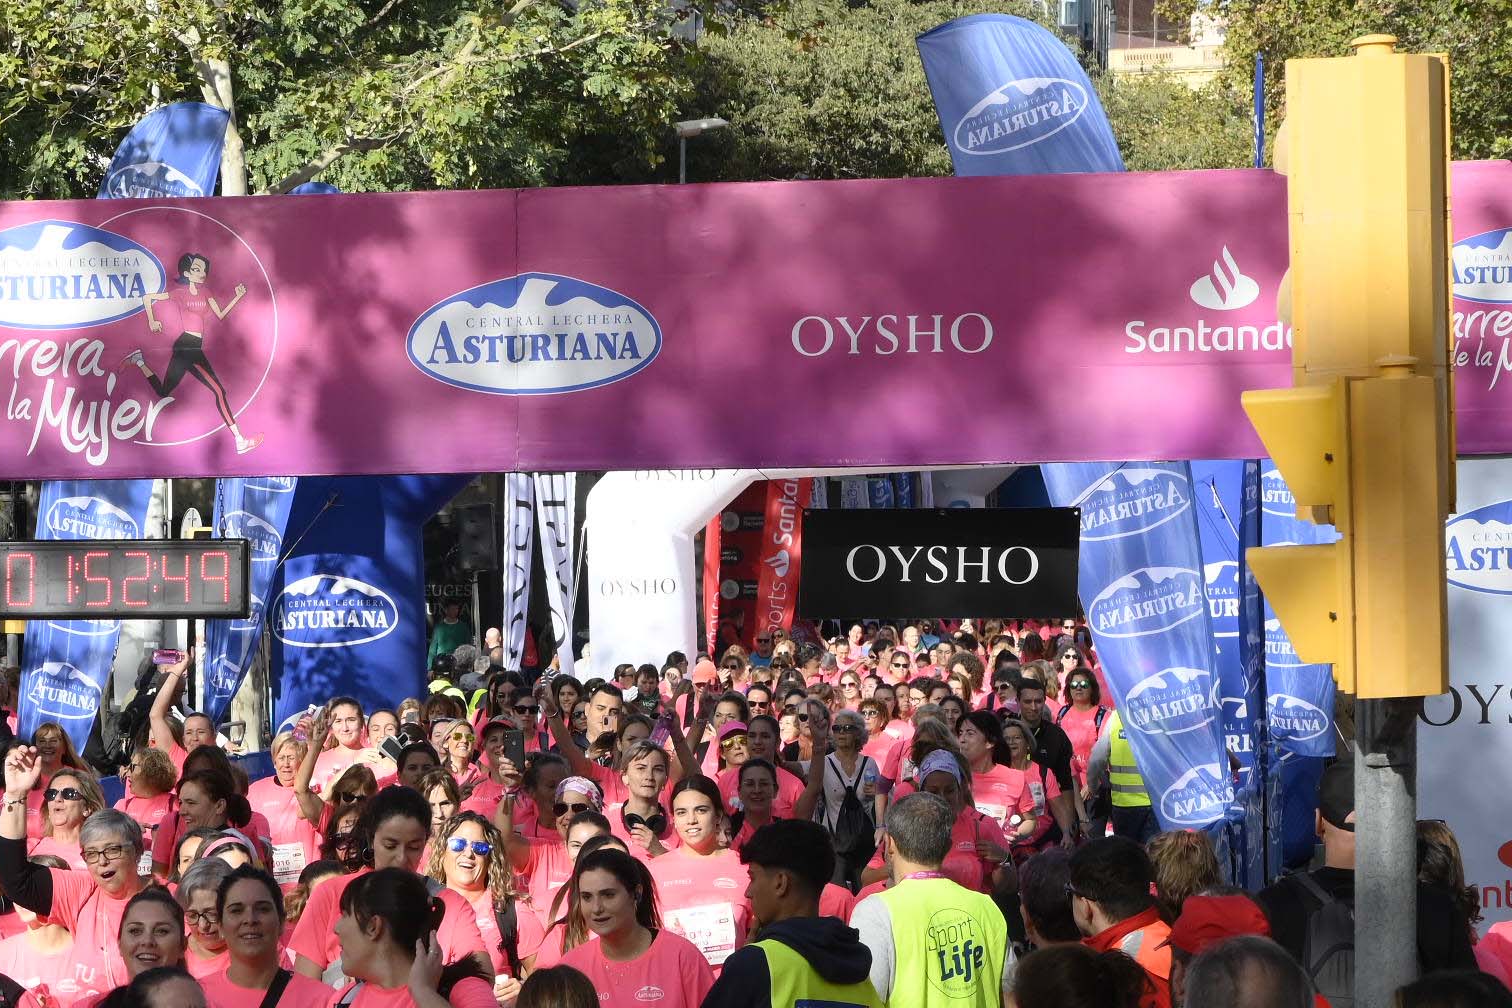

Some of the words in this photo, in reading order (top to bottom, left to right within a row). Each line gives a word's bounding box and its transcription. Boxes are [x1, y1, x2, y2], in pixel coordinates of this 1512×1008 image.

[466, 315, 544, 328] CENTRAL
[553, 313, 633, 326] LECHERA
[791, 312, 994, 357] OYSHO
[426, 320, 642, 364] ASTURIANA
[7, 380, 31, 420] la
[27, 373, 175, 466] Mujer
[774, 479, 799, 547] Santa
[846, 545, 1039, 585] OYSHO
[277, 604, 389, 631] ASTURIANA
[288, 600, 331, 608] CENTRAL
[928, 917, 974, 951] Sport
[938, 940, 983, 982] Life
